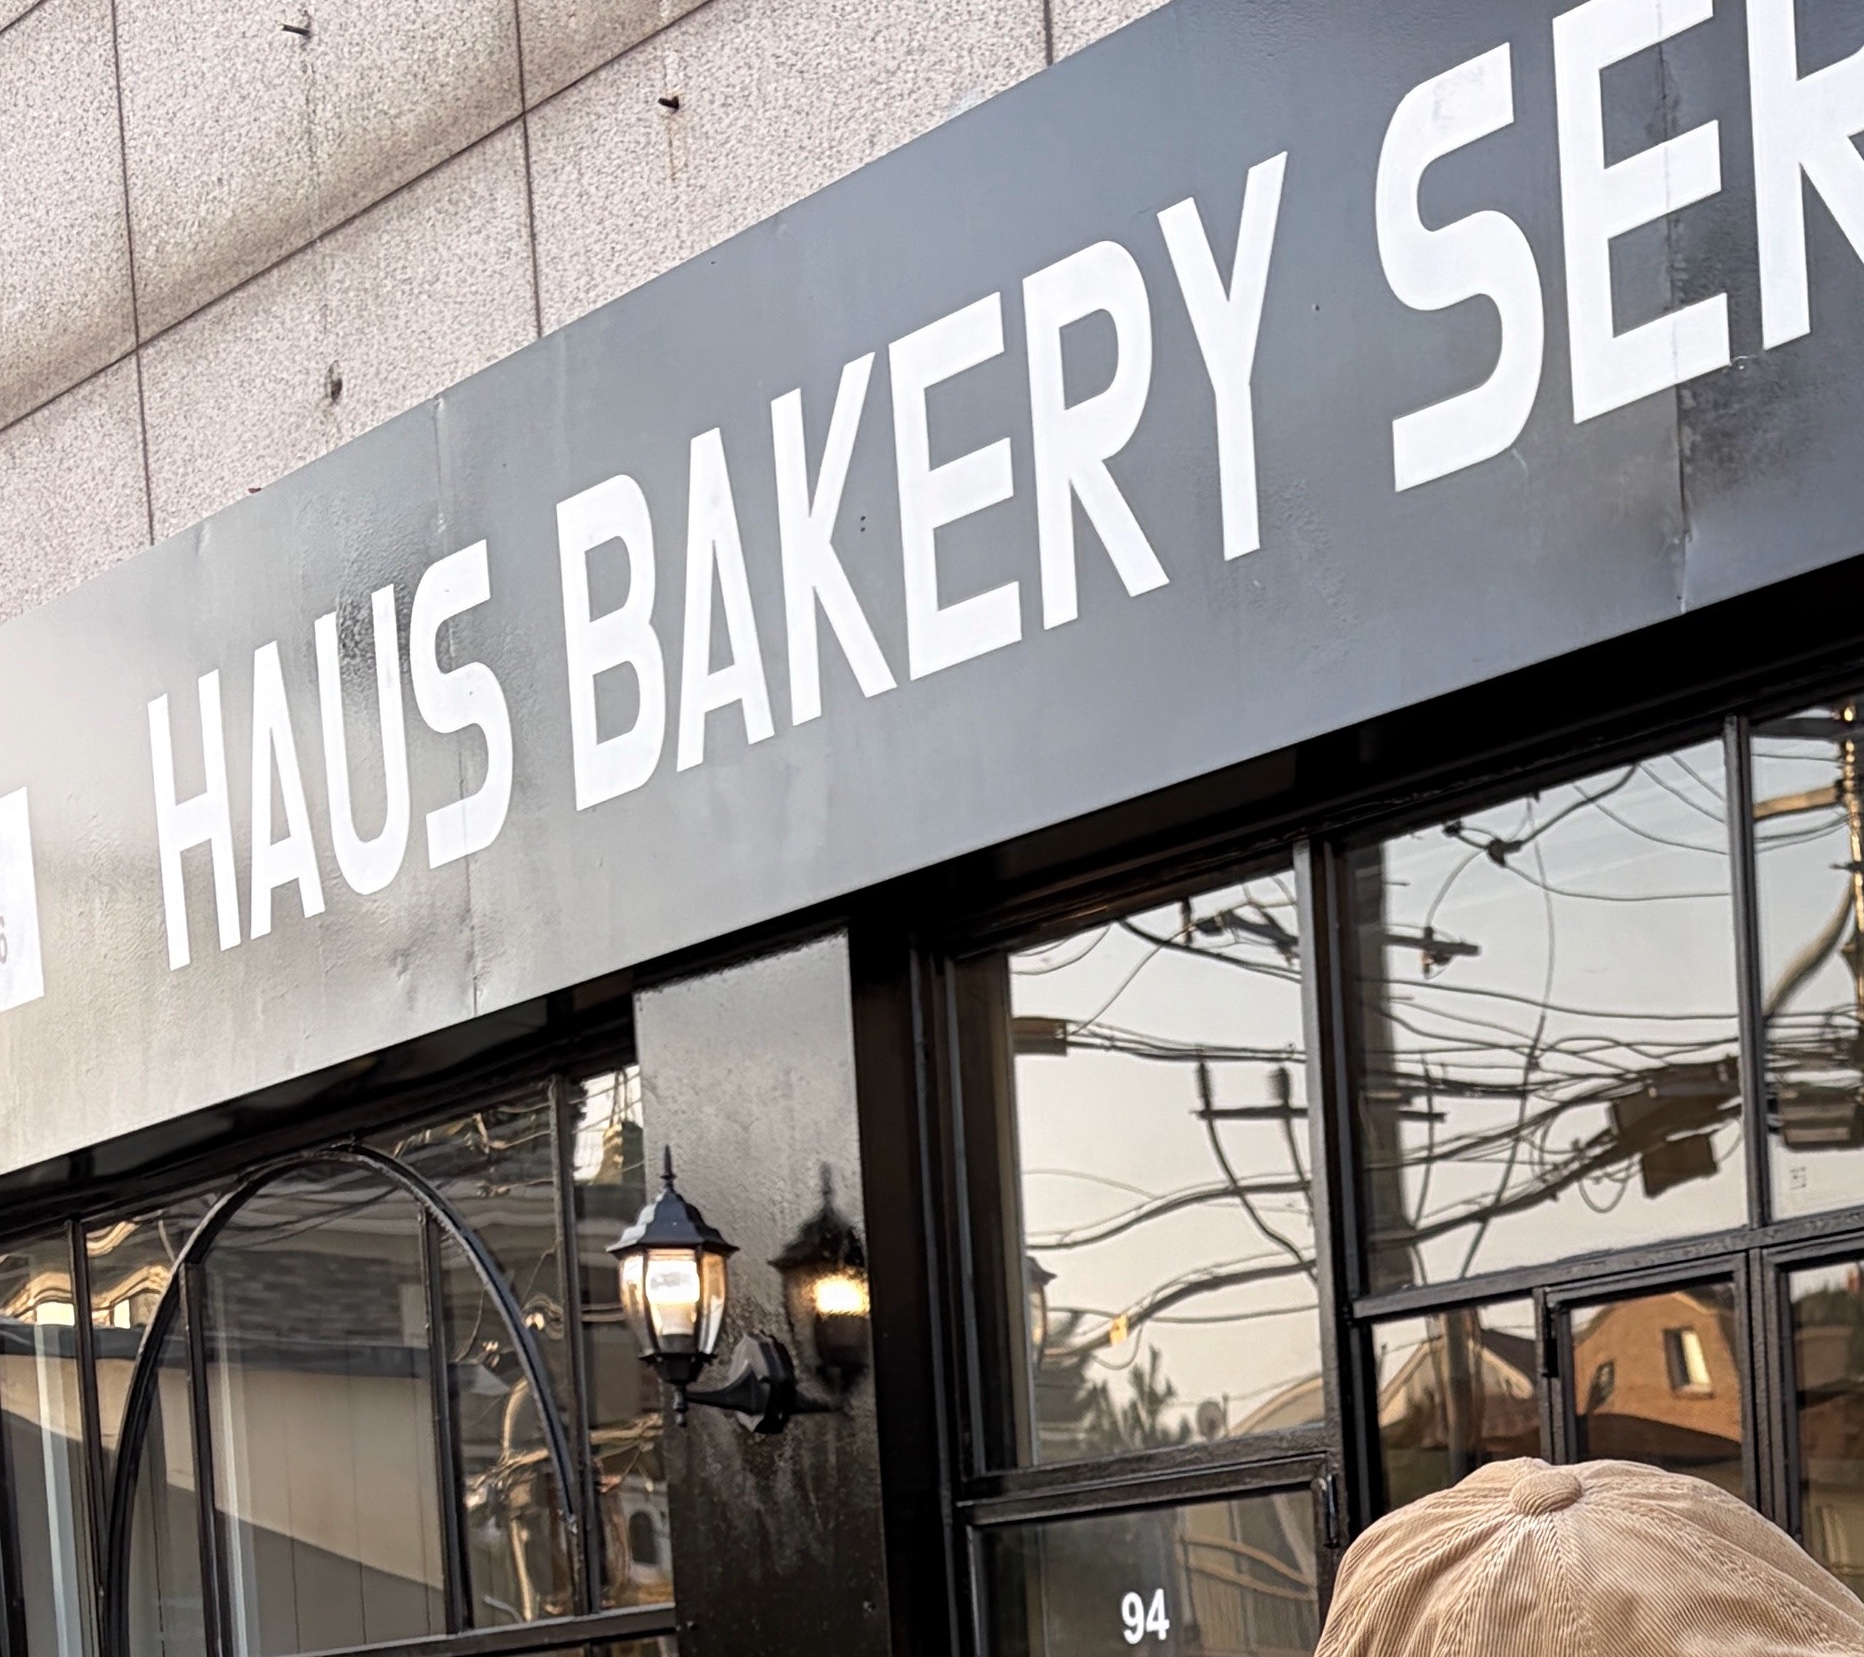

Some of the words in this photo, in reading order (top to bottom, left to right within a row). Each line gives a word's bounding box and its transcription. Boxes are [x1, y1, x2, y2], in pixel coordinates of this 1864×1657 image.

[147, 539, 513, 971] HAUS
[556, 151, 1287, 811] BAKERY
[1121, 1588, 1170, 1645] 94
